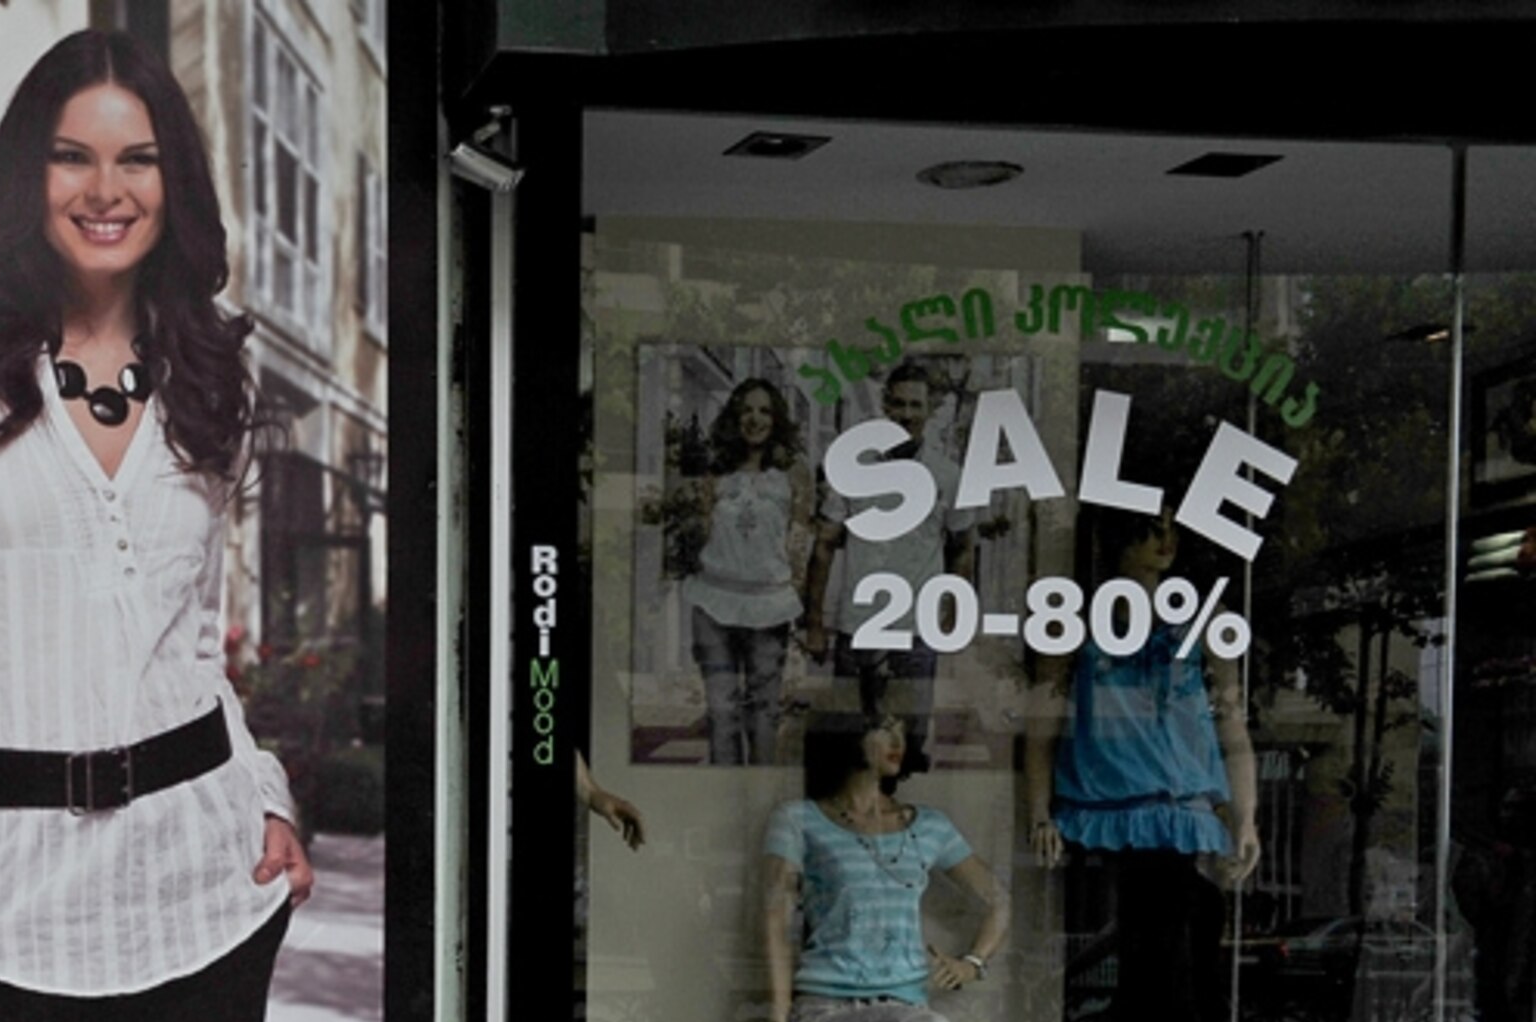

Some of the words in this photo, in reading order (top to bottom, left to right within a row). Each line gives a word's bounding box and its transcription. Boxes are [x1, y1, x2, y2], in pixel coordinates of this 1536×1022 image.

[798, 286, 997, 407] ახალი
[1014, 283, 1320, 428] კოლექცია
[823, 388, 1299, 562] SALE
[530, 545, 558, 657] Rodi
[851, 572, 1252, 659] 20-80%
[530, 657, 559, 765] Mood
